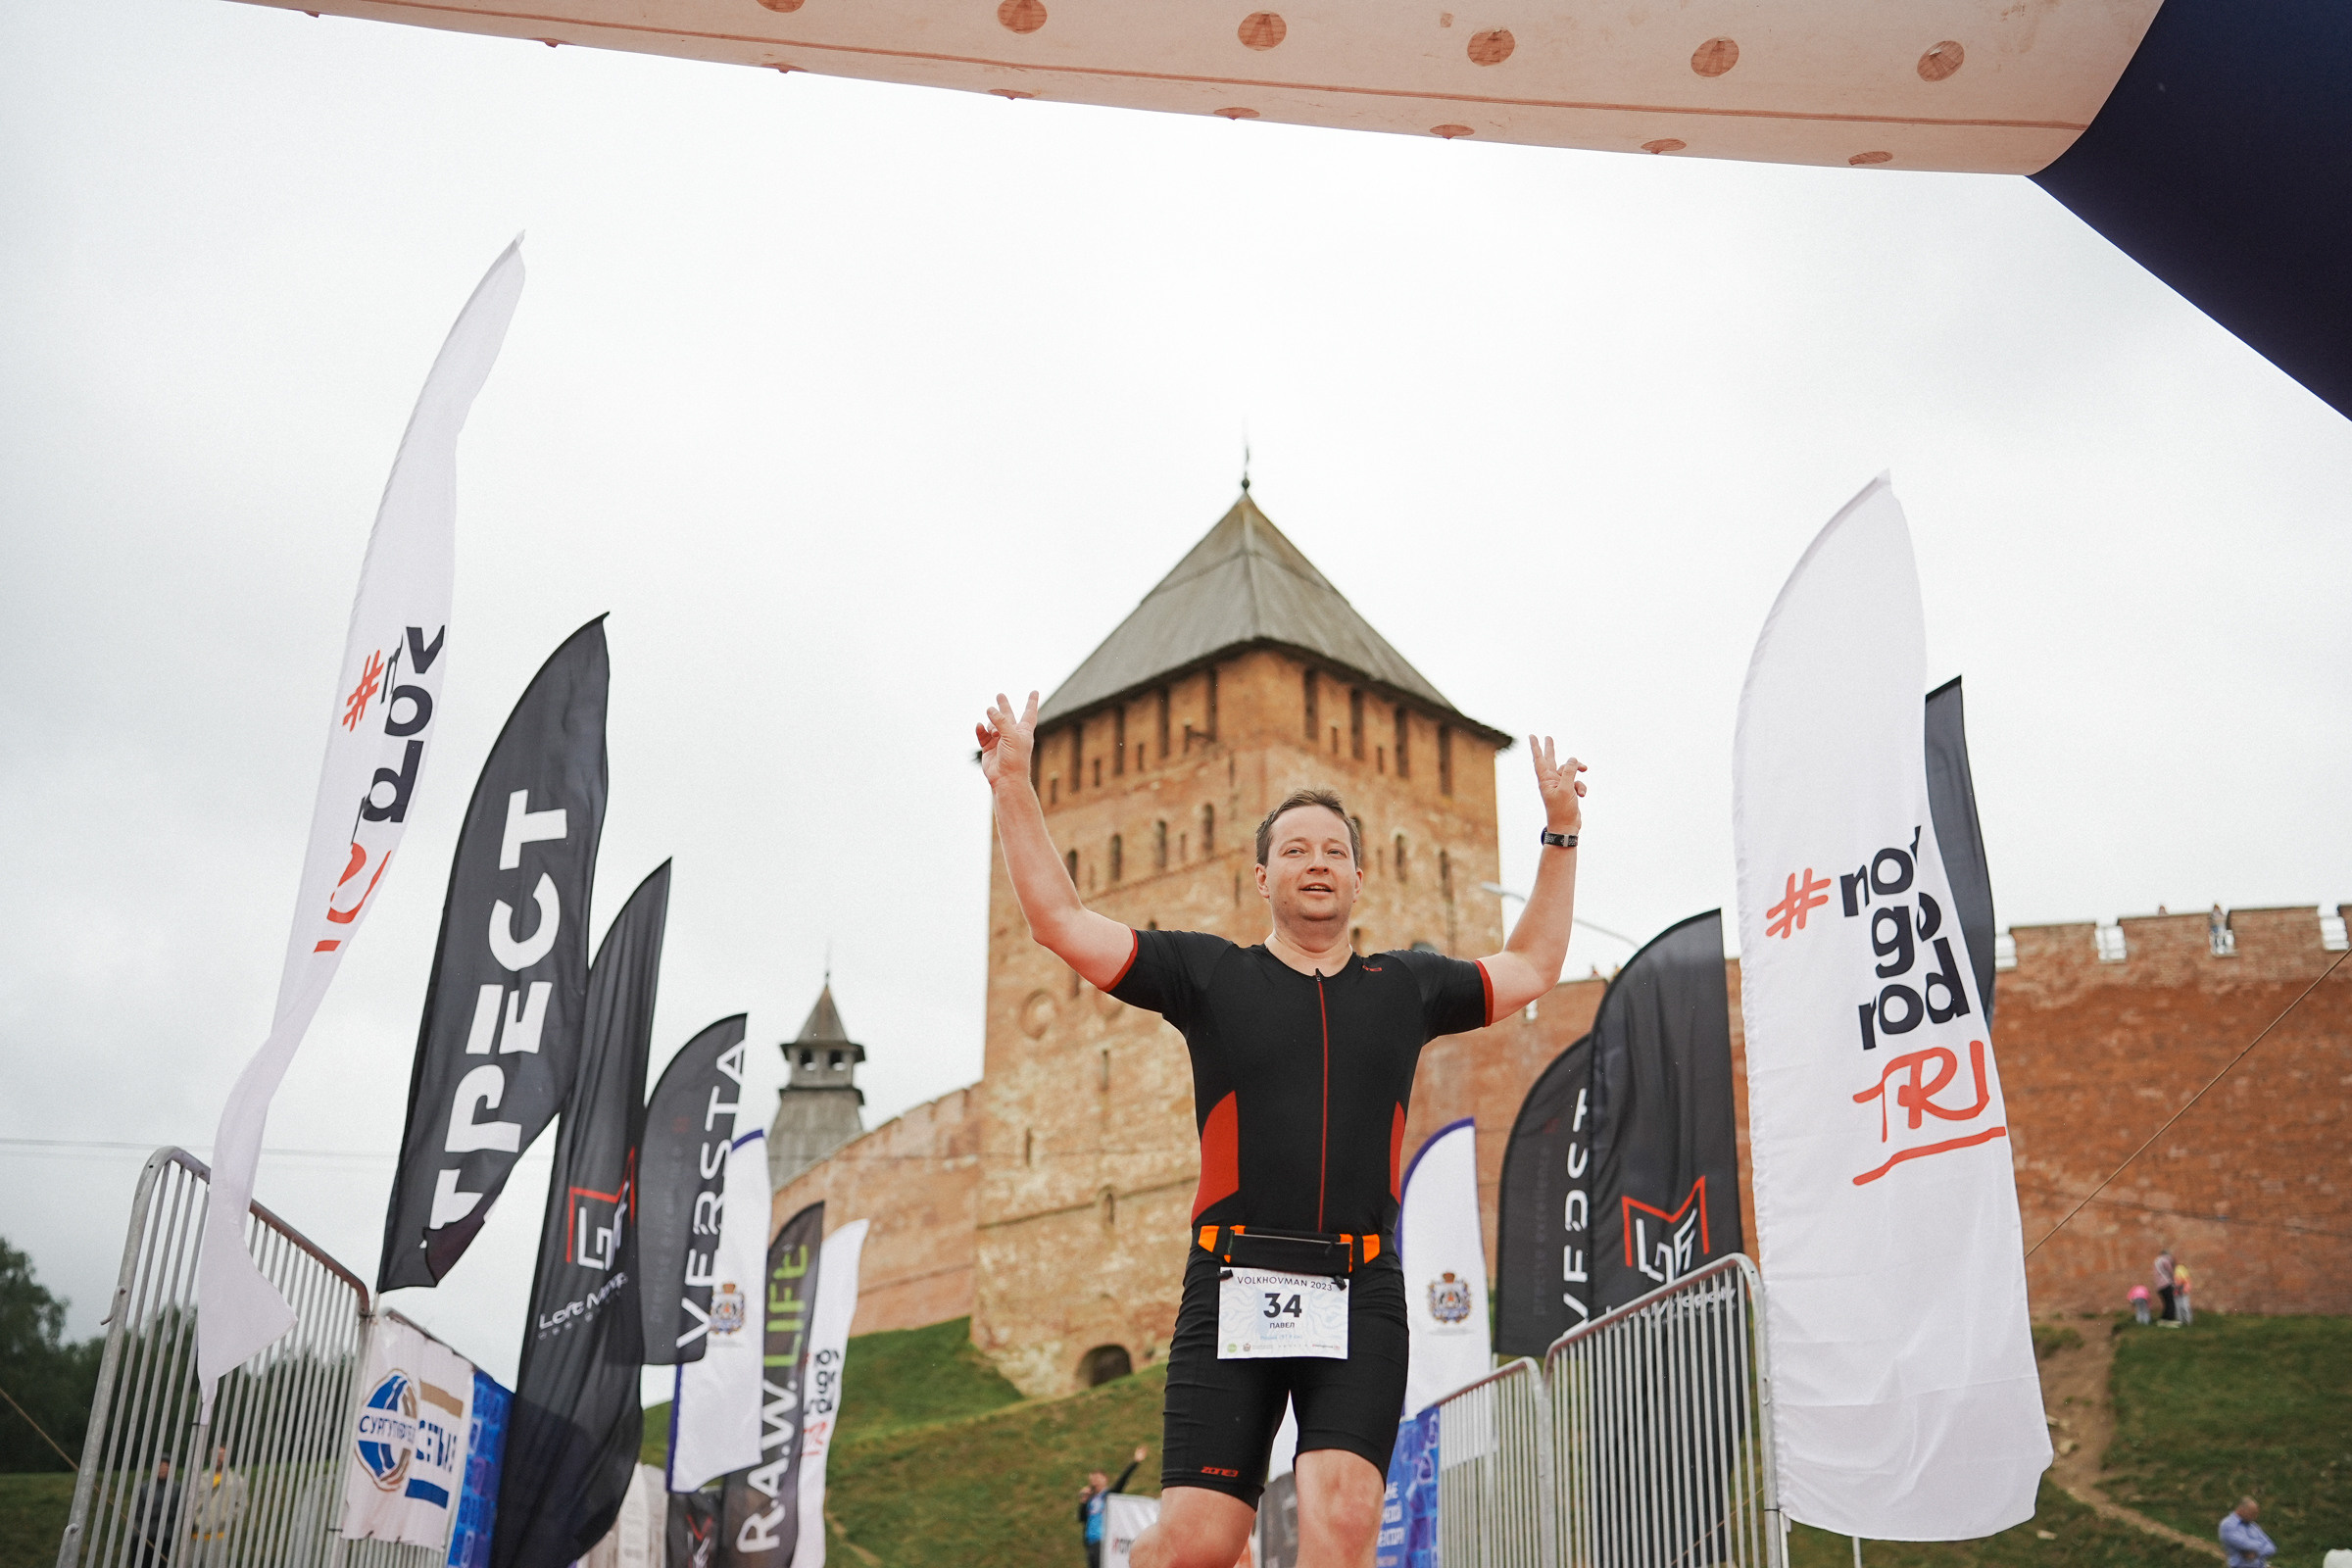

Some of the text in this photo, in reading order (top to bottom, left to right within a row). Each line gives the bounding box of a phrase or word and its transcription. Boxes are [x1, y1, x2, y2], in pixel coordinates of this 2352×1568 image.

[676, 1039, 747, 1348] VERSTA
[1237, 1276, 1333, 1292] VOLKHOVMAN 2023
[1263, 1293, 1302, 1318] 34
